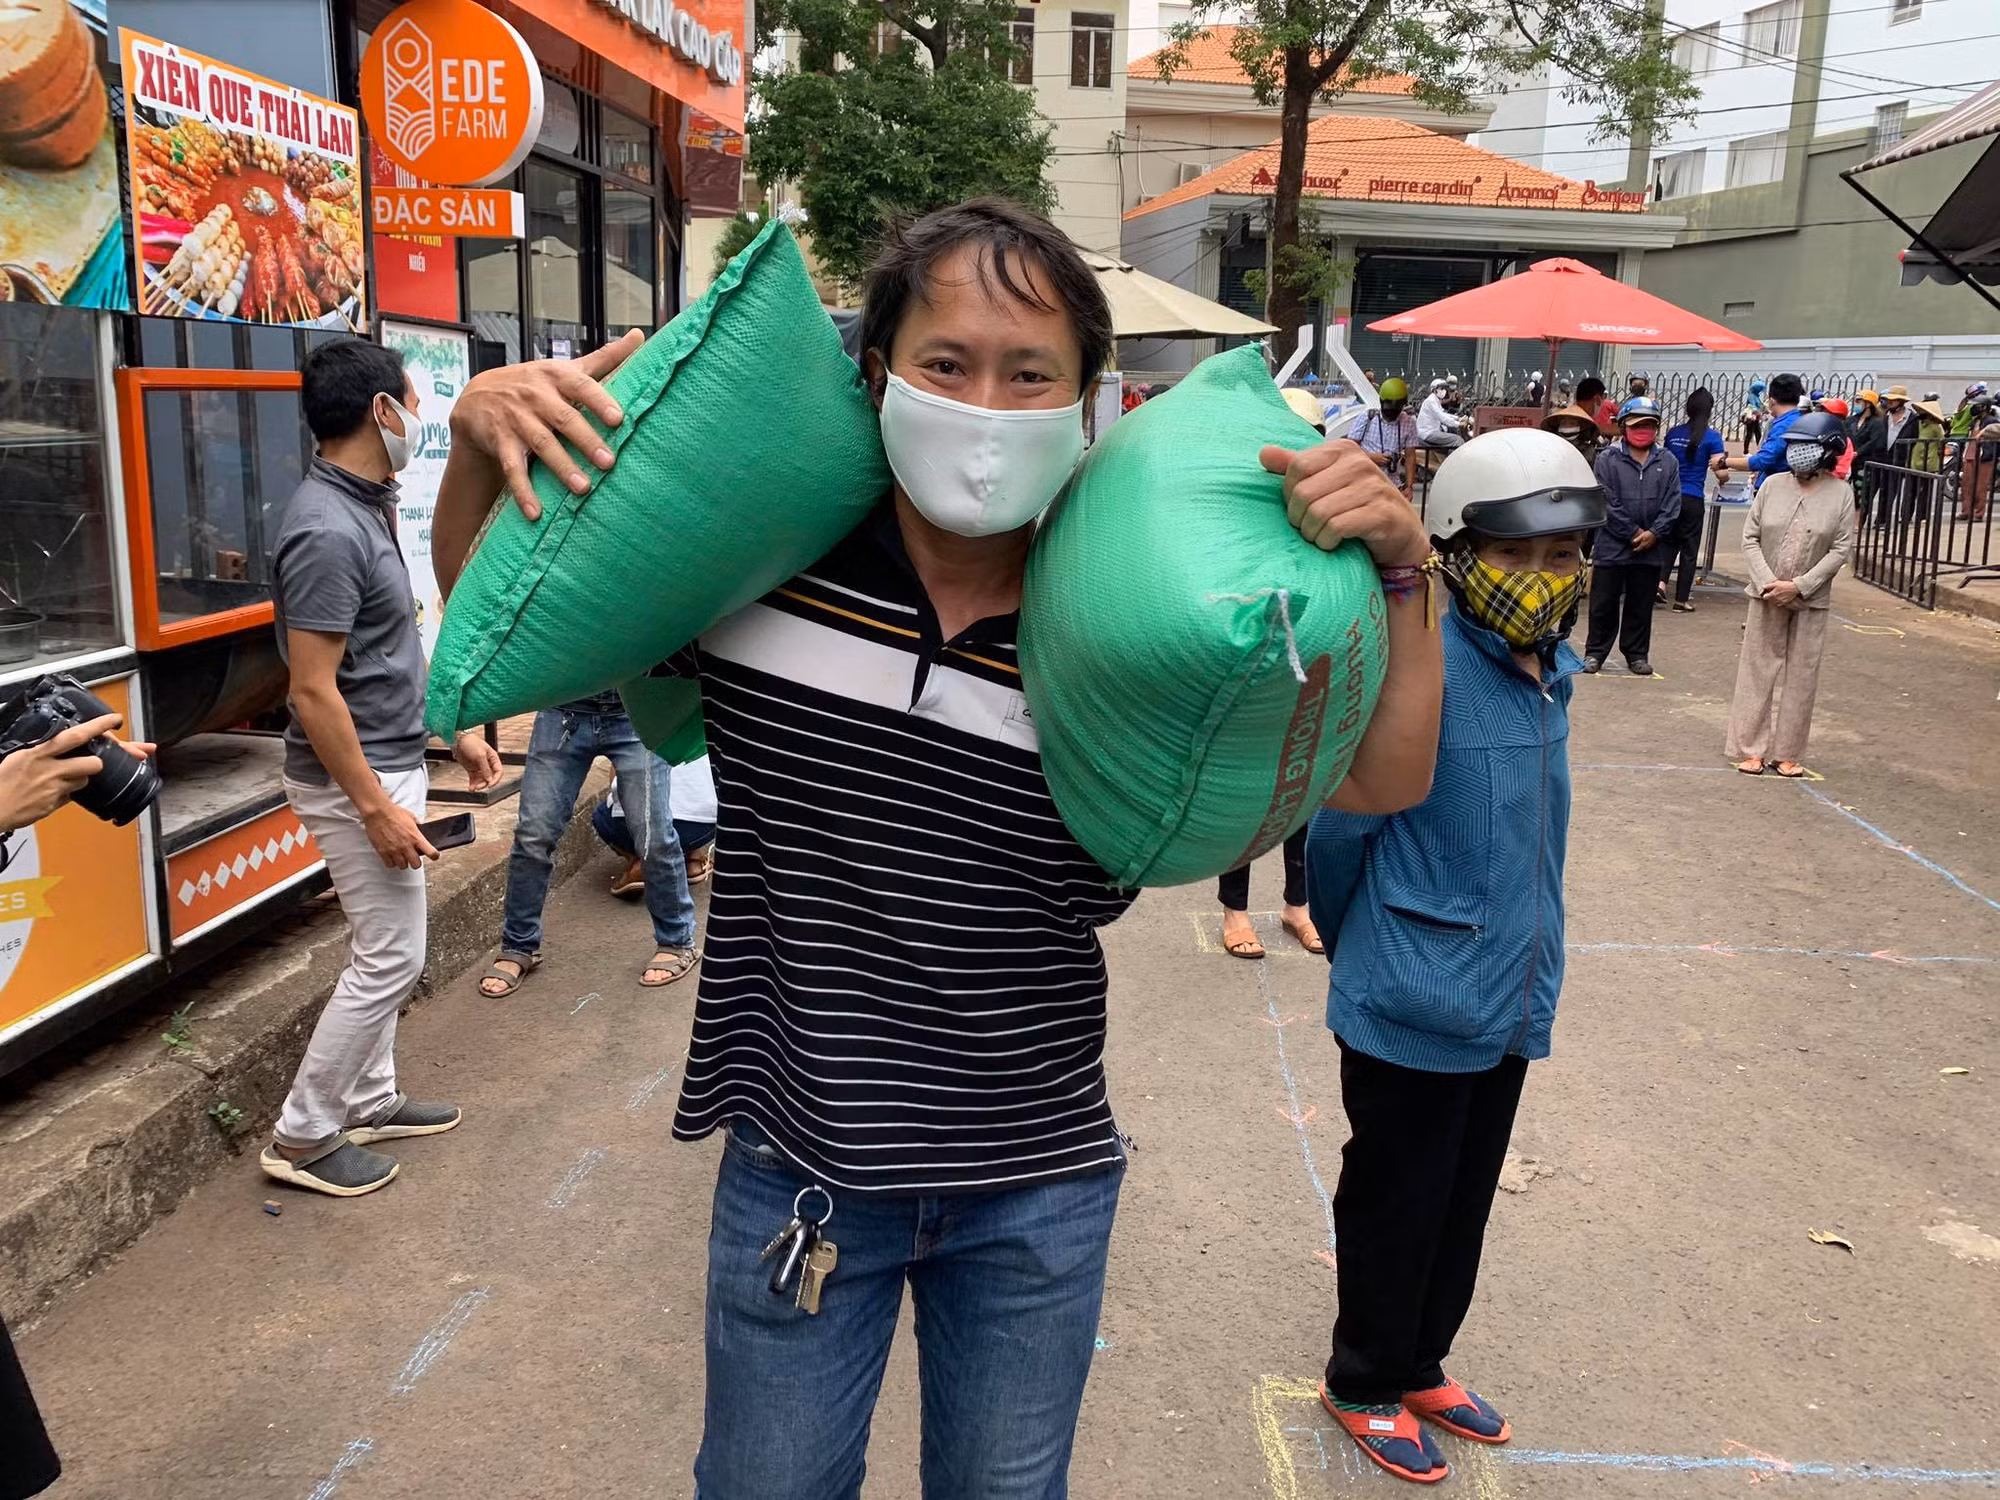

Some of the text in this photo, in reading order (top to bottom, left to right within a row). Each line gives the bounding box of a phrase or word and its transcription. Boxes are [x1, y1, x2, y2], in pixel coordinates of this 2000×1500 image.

[679, 11, 711, 69] CAO
[136, 47, 354, 158] XIÊN QUE THÁI LAN
[441, 58, 507, 104] EDE
[442, 107, 507, 139] FARM
[1369, 176, 1474, 197] pierre cardin
[374, 191, 497, 232] ĐẶC SẢN
